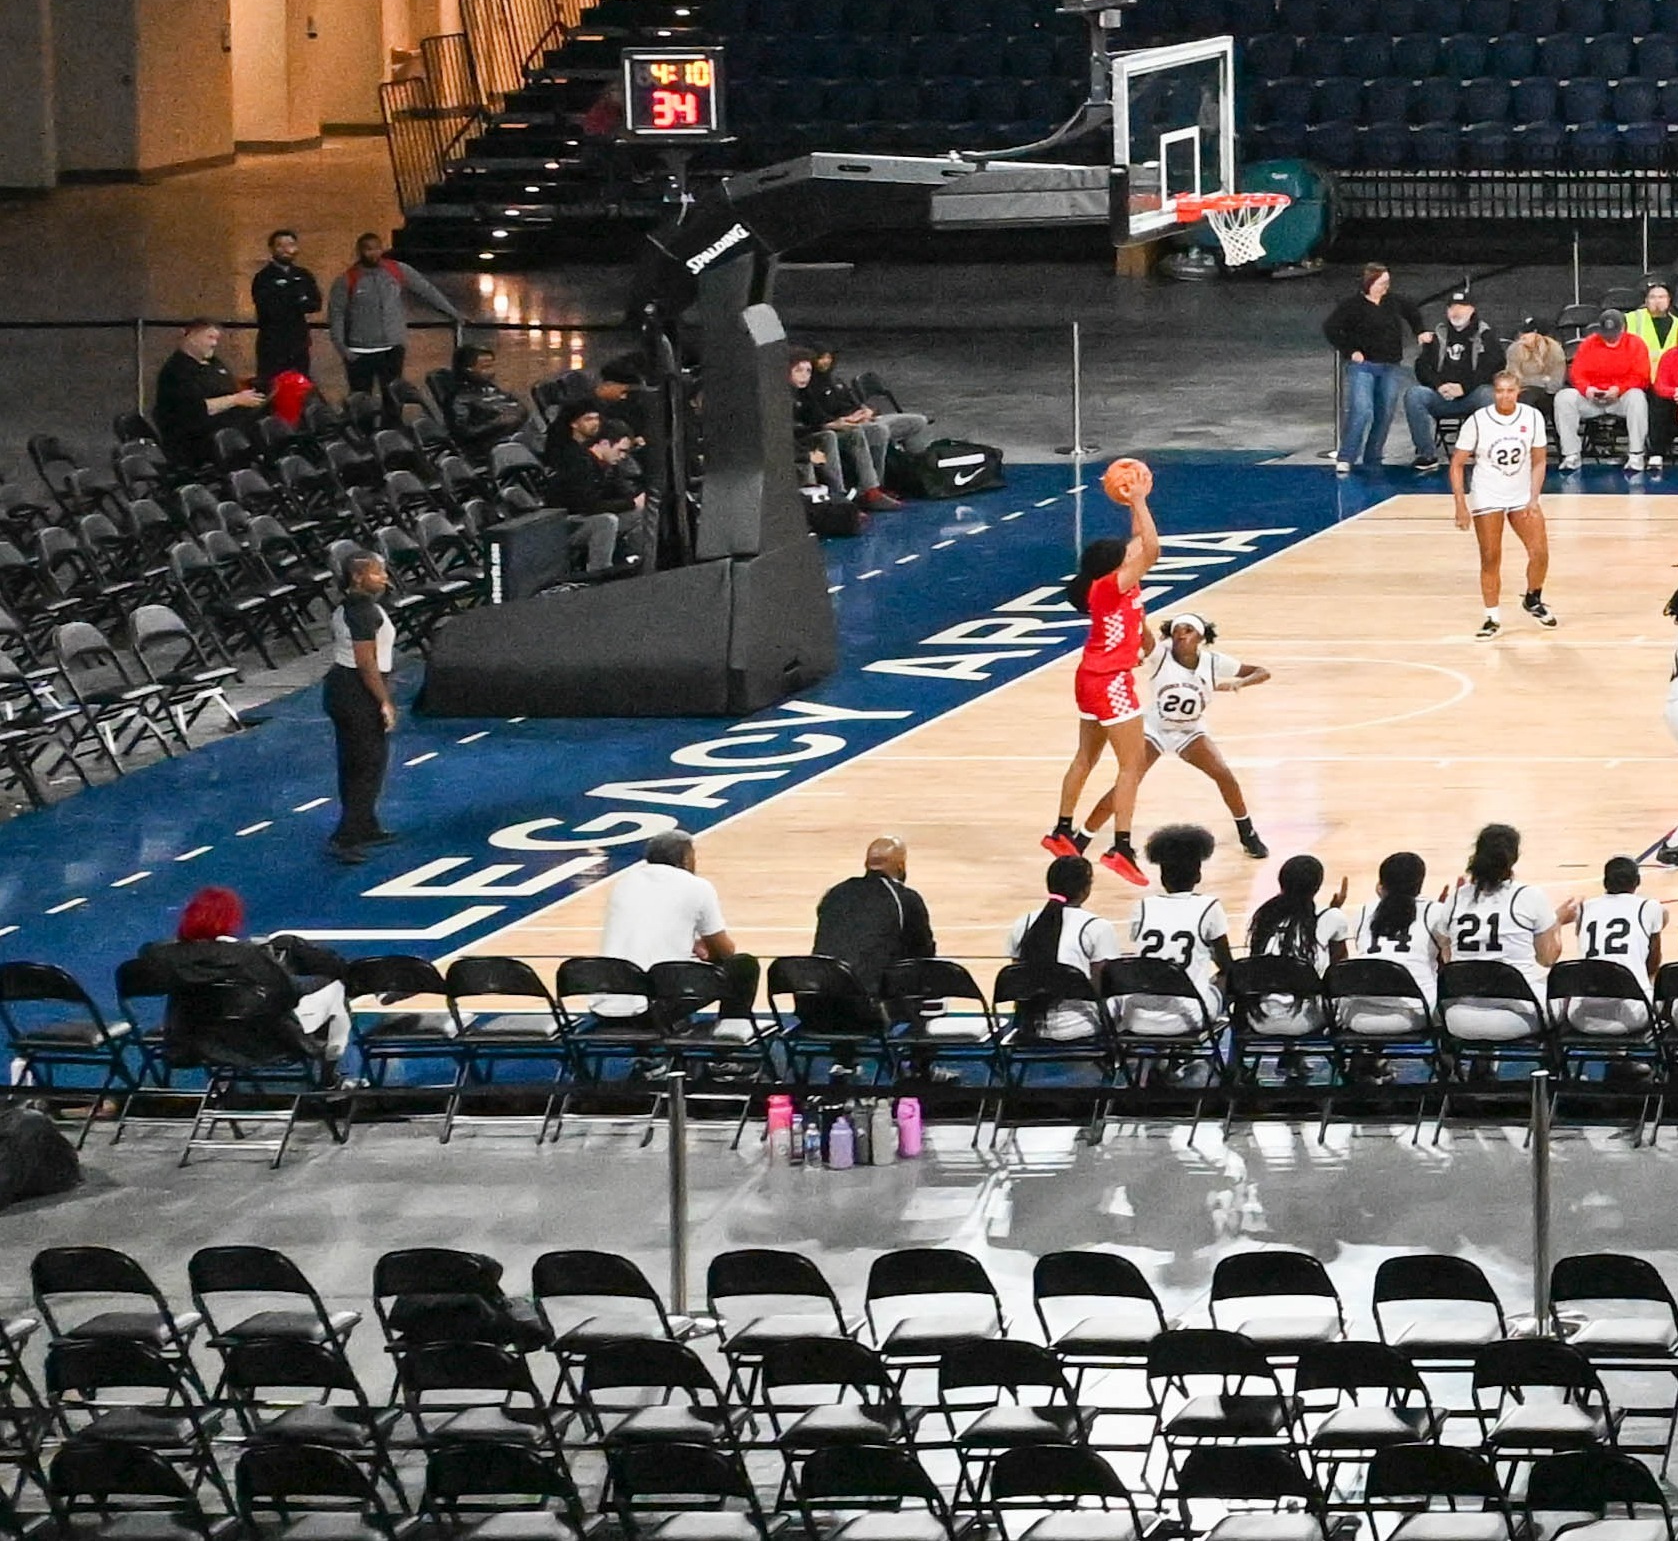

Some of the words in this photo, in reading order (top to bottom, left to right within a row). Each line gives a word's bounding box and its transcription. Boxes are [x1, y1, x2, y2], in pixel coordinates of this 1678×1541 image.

[649, 60, 711, 88] 4:10
[651, 89, 699, 128] 34
[685, 222, 751, 275] SPALDING
[1496, 447, 1522, 466] 22
[1162, 694, 1197, 715] 20
[252, 699, 914, 946] LEGACY
[1141, 929, 1196, 969] 23
[1456, 912, 1503, 952] 21
[1585, 917, 1631, 960] 12
